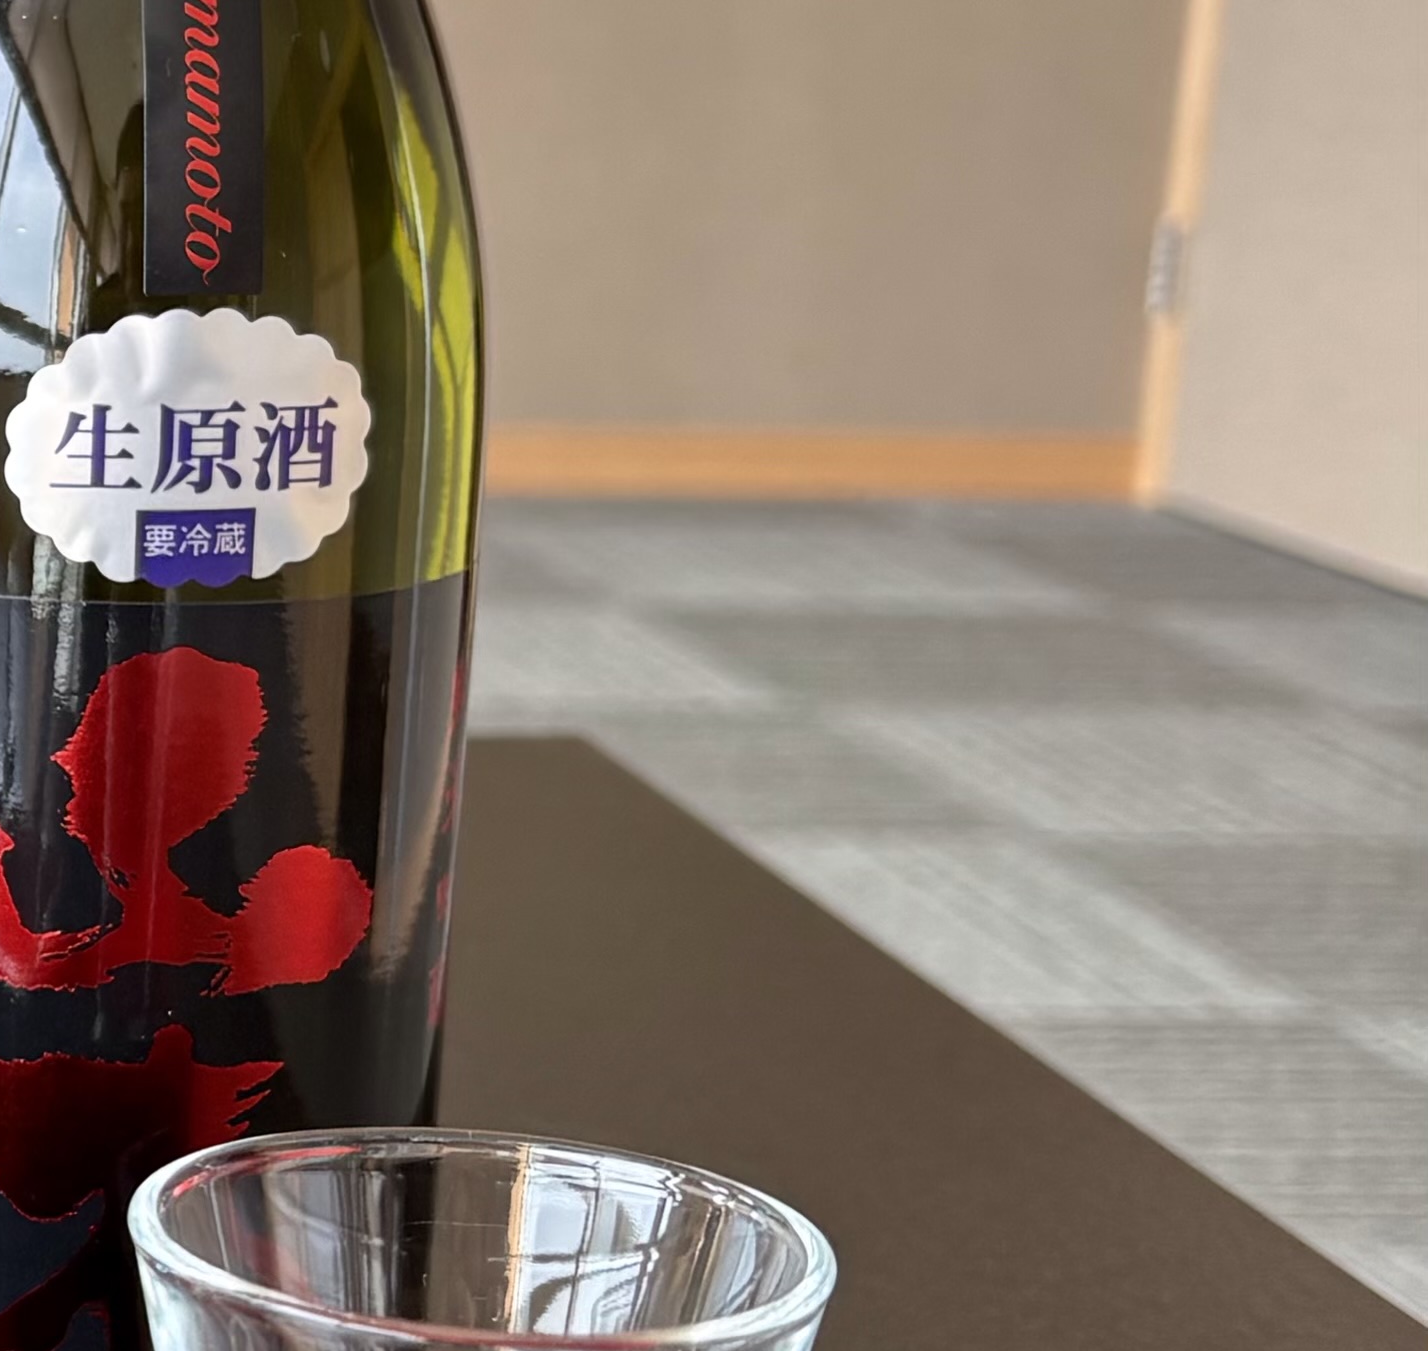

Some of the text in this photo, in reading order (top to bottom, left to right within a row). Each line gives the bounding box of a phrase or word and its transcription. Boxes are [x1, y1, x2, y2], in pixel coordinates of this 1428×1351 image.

[49, 396, 339, 494] 生原酒
[143, 522, 247, 558] 要冷蔵
